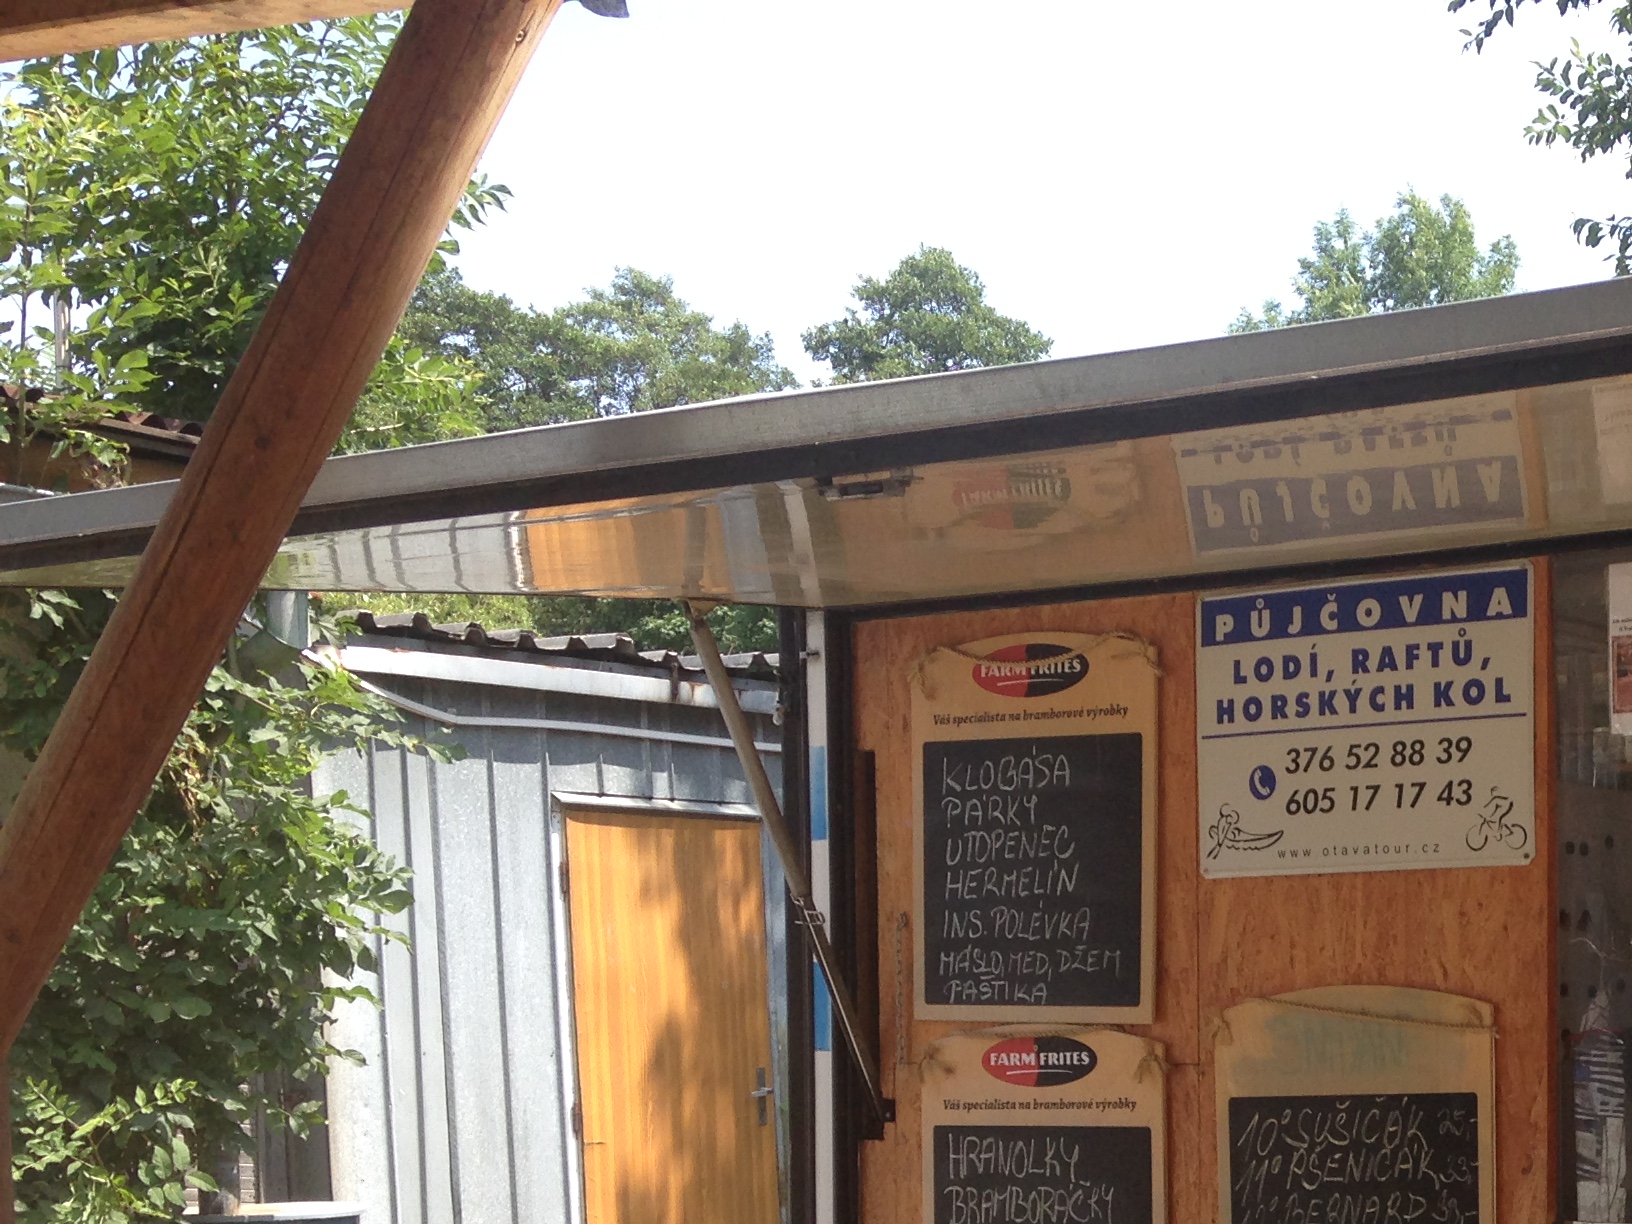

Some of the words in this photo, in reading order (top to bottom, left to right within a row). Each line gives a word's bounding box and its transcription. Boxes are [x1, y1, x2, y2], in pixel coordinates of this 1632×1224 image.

[1215, 586, 1512, 642] PŮJČOVNA
[1233, 643, 1335, 685] LODÍ,
[1351, 627, 1491, 675] RAFTŮ,
[933, 713, 950, 726] Váš
[952, 710, 1007, 728] specialista
[1008, 712, 1021, 722] na
[1023, 706, 1084, 722] bramborové
[1086, 703, 1129, 719] výrobky
[1216, 679, 1415, 725] HORSKÝCH
[1433, 677, 1511, 709] KOL
[941, 745, 1071, 796] KLOBÁSA
[1285, 745, 1336, 774] 376
[1345, 742, 1381, 770] 52
[1390, 739, 1426, 767] 88
[1436, 736, 1472, 764] 39
[941, 793, 1039, 828] PÁRKY
[1285, 787, 1336, 816] 605
[1349, 784, 1381, 811] 17
[1394, 781, 1426, 809] 17
[1437, 779, 1472, 807] 43
[945, 825, 1077, 866] UTOPENEC
[944, 859, 1080, 900] HERMELÍN
[943, 909, 988, 939] INS.
[991, 899, 1091, 941] POLÉVKA
[1056, 945, 1121, 977] DŽEM
[943, 974, 1048, 1004] PAŠTIKA
[990, 1052, 1036, 1066] FARM
[1039, 1051, 1090, 1066] FRITES
[943, 1099, 960, 1110] Váš
[962, 1098, 1016, 1113] specialista
[1018, 1102, 1031, 1110] na
[1033, 1097, 1094, 1110] bramborové
[1095, 1097, 1137, 1113] výrobky
[948, 1132, 1079, 1183] HRANOLKY
